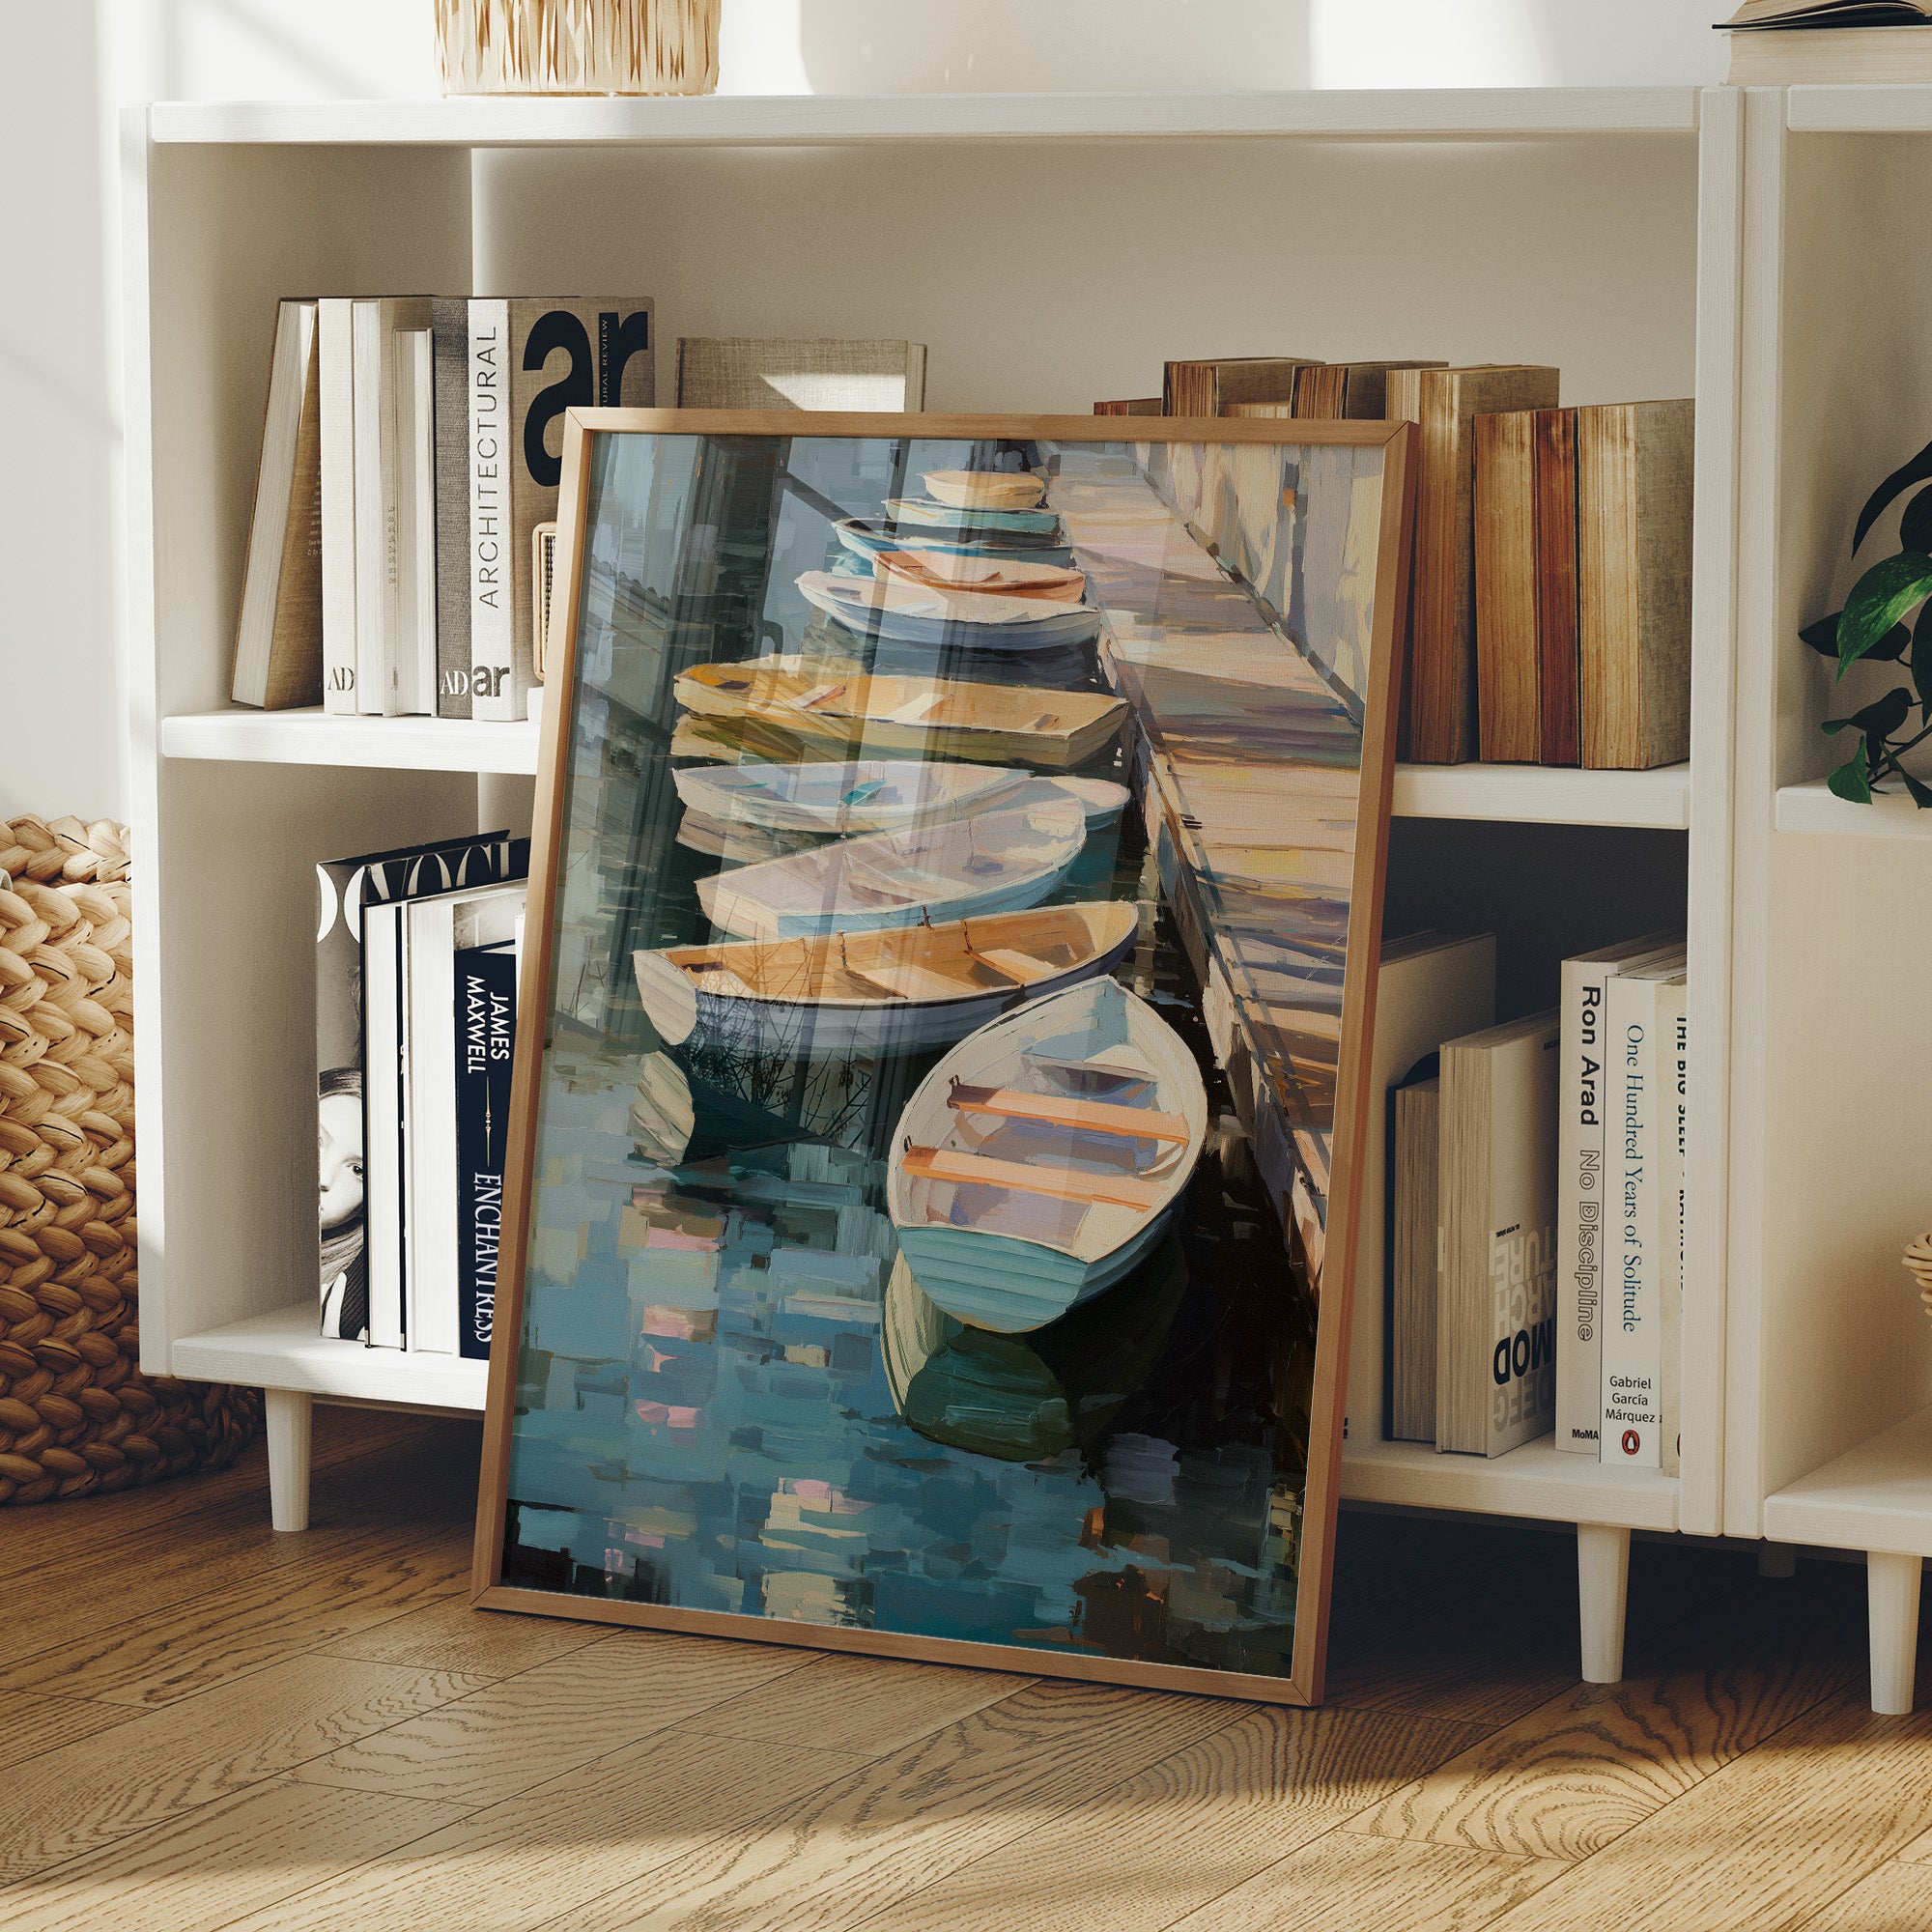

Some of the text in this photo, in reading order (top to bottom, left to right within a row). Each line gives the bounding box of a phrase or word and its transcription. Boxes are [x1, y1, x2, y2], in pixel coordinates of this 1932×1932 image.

[523, 310, 648, 487] ar
[476, 327, 498, 609] ARCHITECTURAL
[327, 667, 355, 692] AD
[440, 669, 469, 696] AD
[472, 665, 510, 697] ar
[467, 975, 486, 1074] MAXWELL
[490, 991, 510, 1061] JAMES
[1575, 986, 1601, 1342] Ron Arad No Discipline
[1623, 1024, 1644, 1332] One Hundred Years of Solitude
[1492, 1318, 1552, 1385] MOD
[1609, 1376, 1652, 1389] Gabriel
[1611, 1392, 1648, 1406] García
[1572, 1428, 1599, 1440] MoMA
[1605, 1408, 1656, 1424] Márquez
